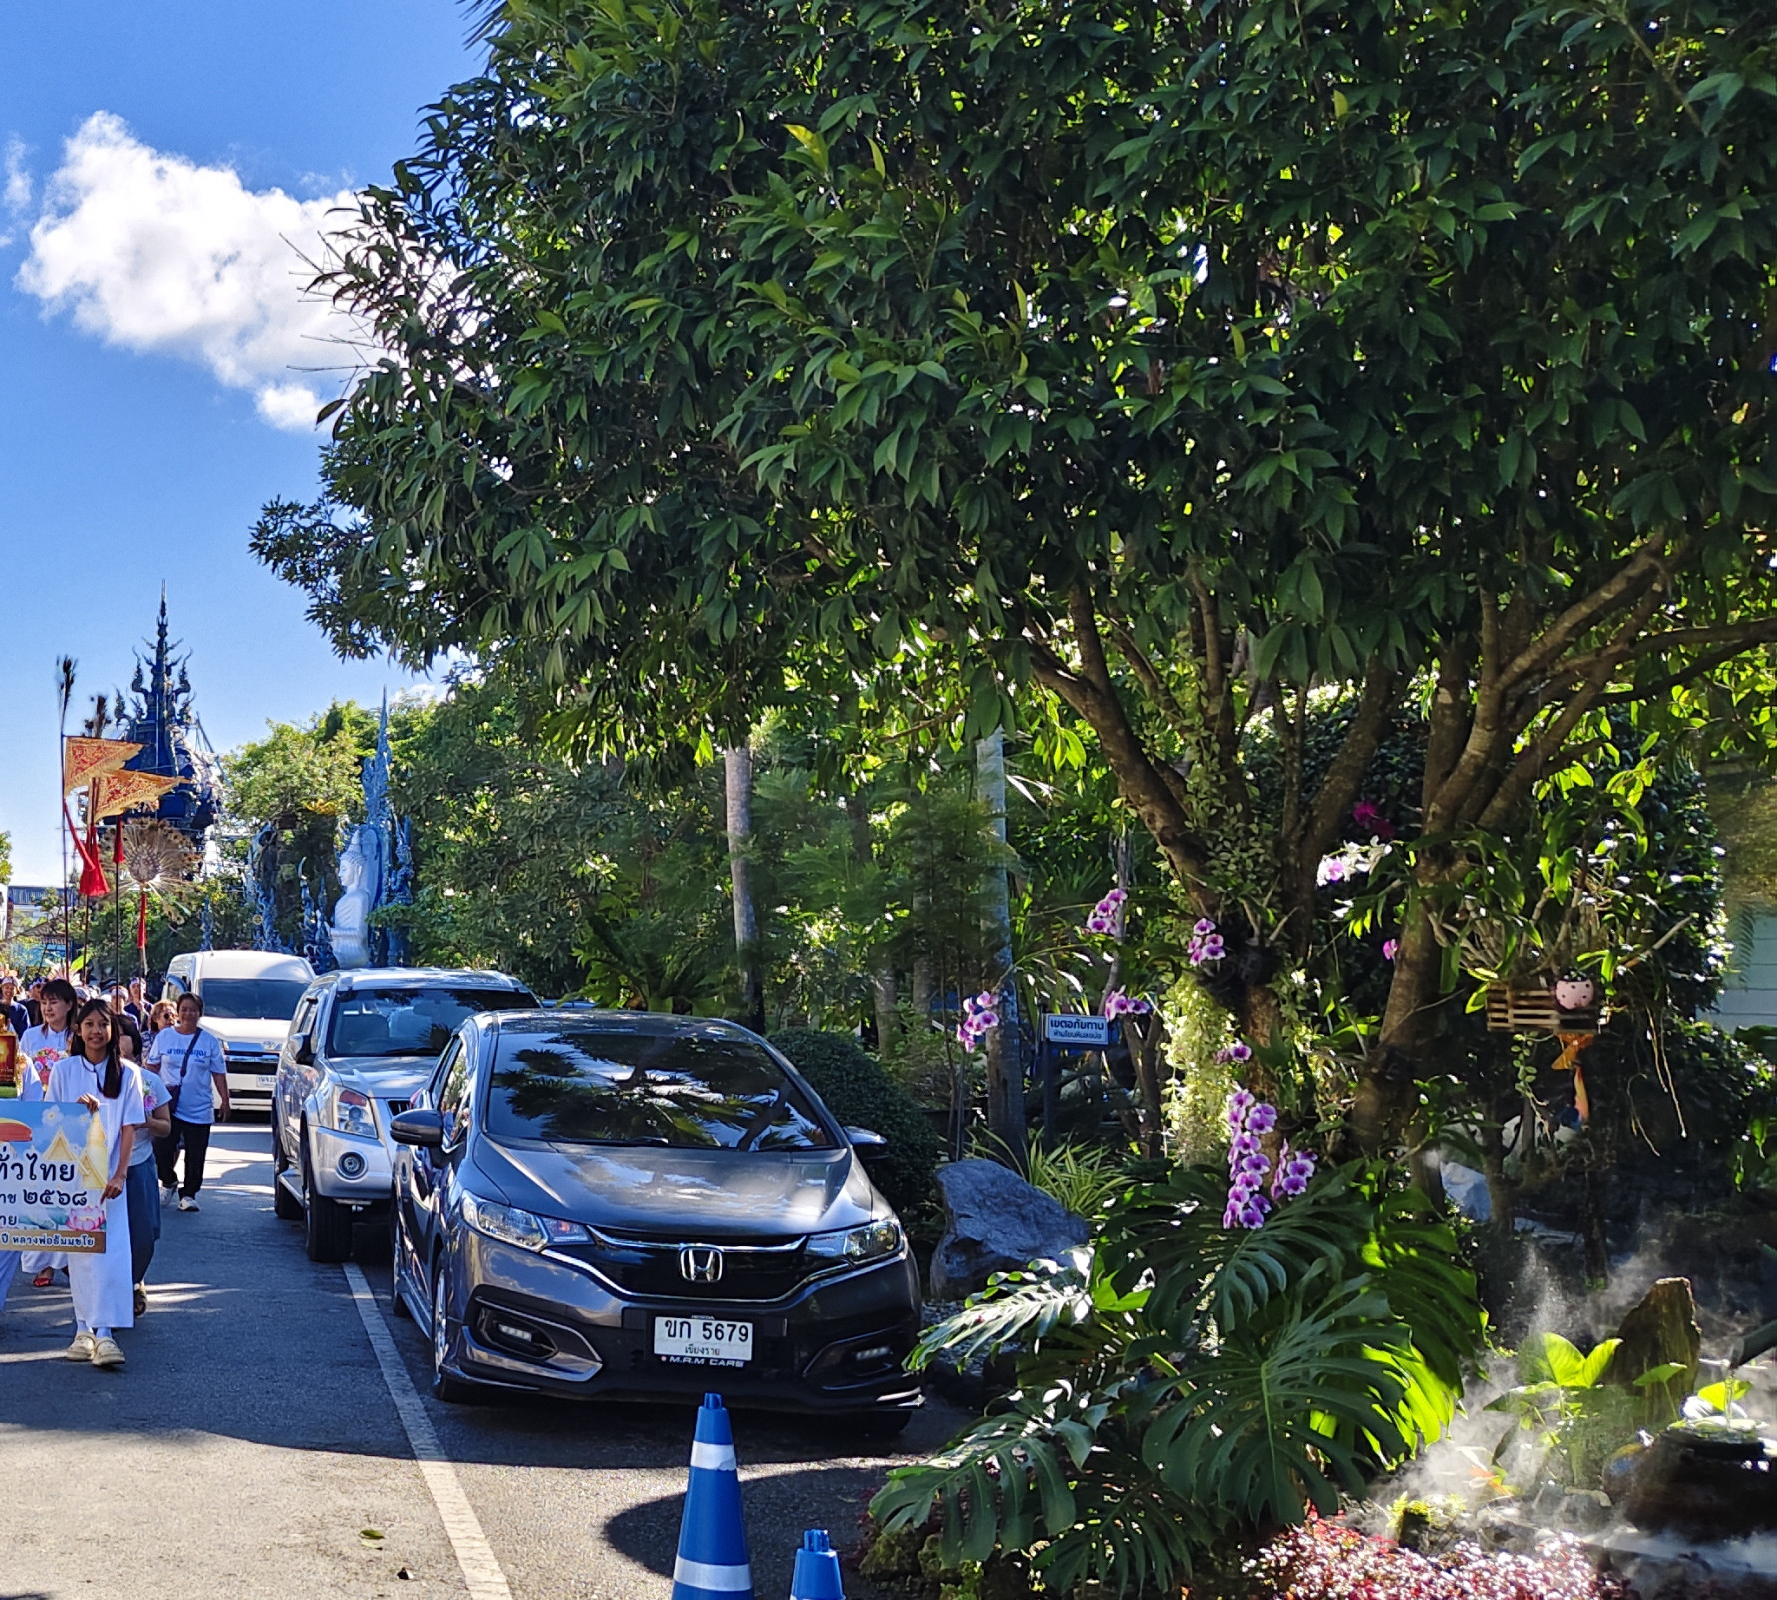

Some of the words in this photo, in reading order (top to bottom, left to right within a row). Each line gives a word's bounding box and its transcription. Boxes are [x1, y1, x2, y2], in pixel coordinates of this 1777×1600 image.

[22, 1189, 88, 1206] ๒๕๖๘
[664, 1319, 692, 1339] ขก
[702, 1321, 749, 1343] 5679
[684, 1343, 721, 1356] เชียงราย
[669, 1355, 705, 1366] M.R.M
